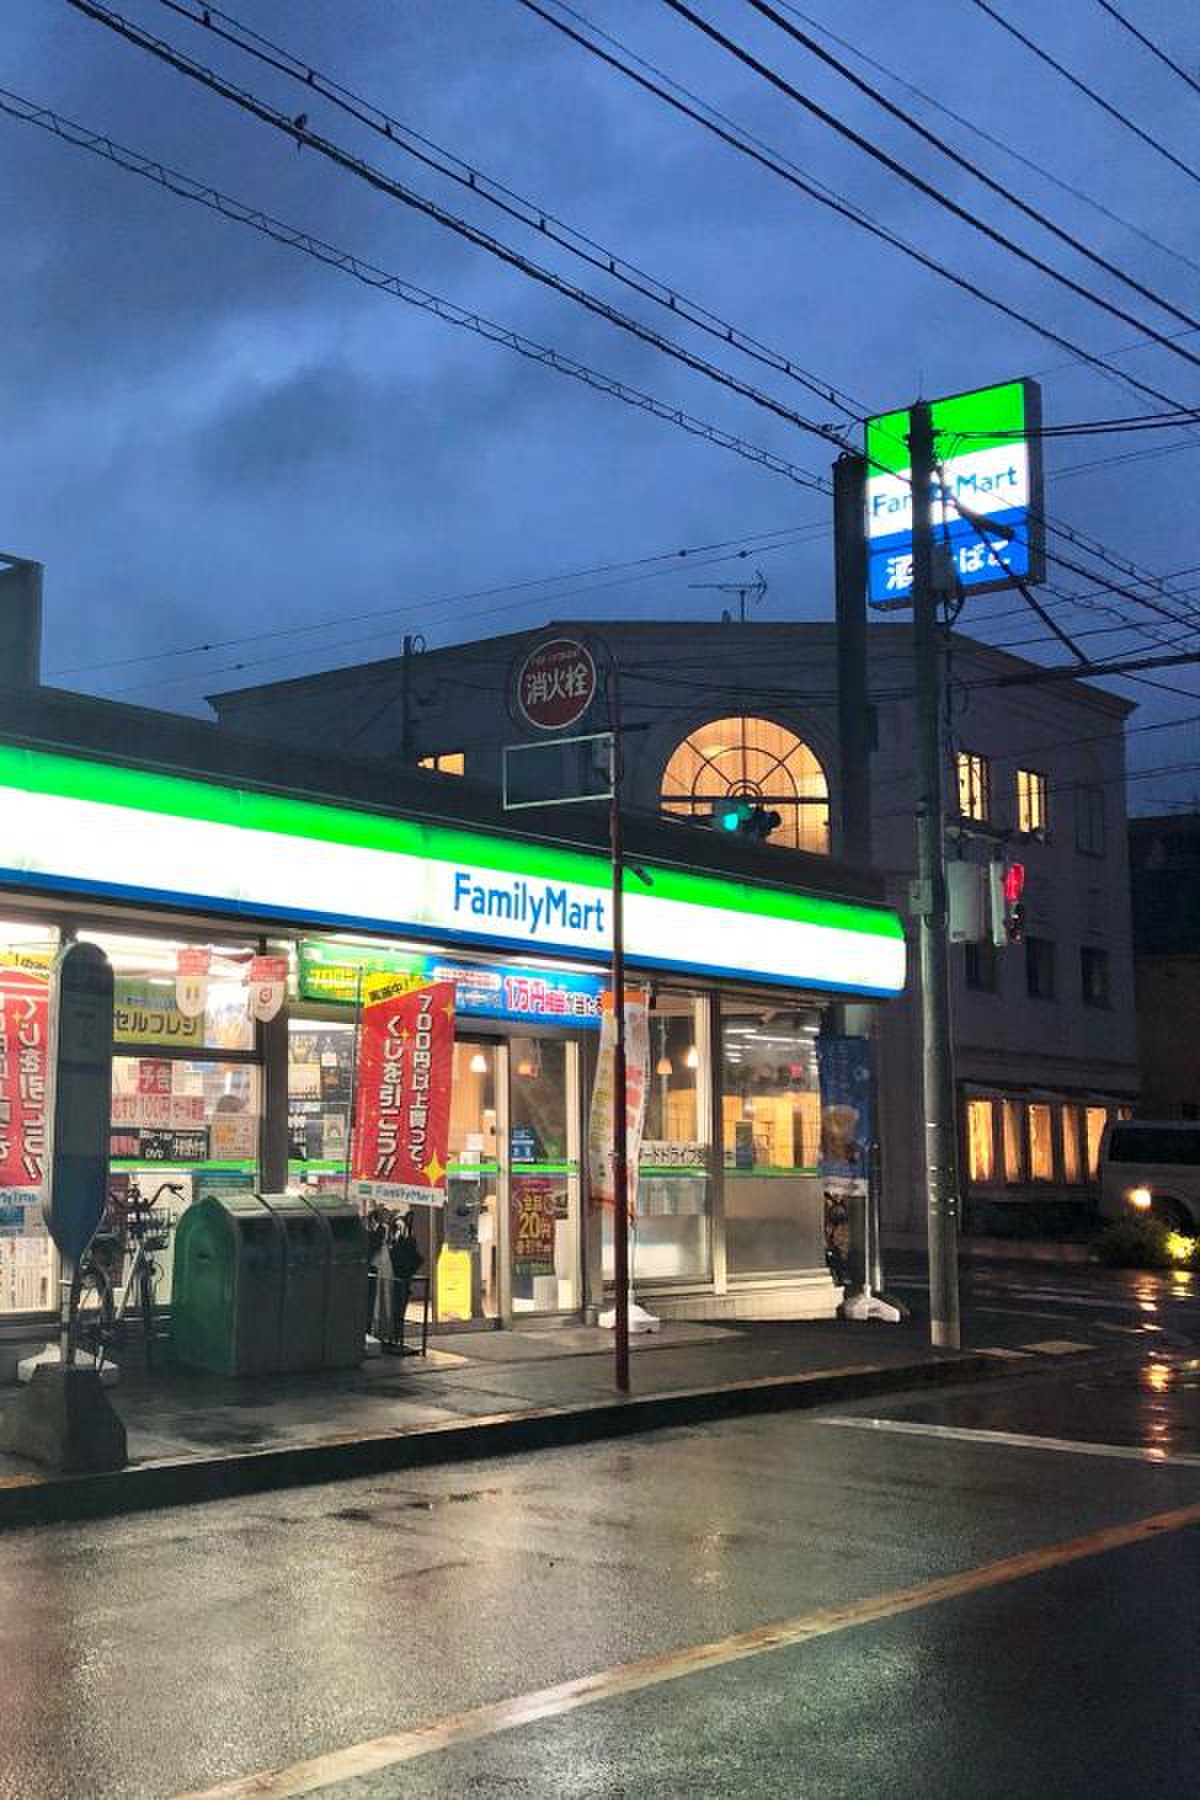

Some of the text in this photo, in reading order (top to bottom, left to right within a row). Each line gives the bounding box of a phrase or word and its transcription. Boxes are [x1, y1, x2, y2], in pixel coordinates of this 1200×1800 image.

[885, 540, 1011, 590] 酒ばこ
[527, 662, 589, 704] 消火栓
[453, 872, 605, 934] FamilyMart
